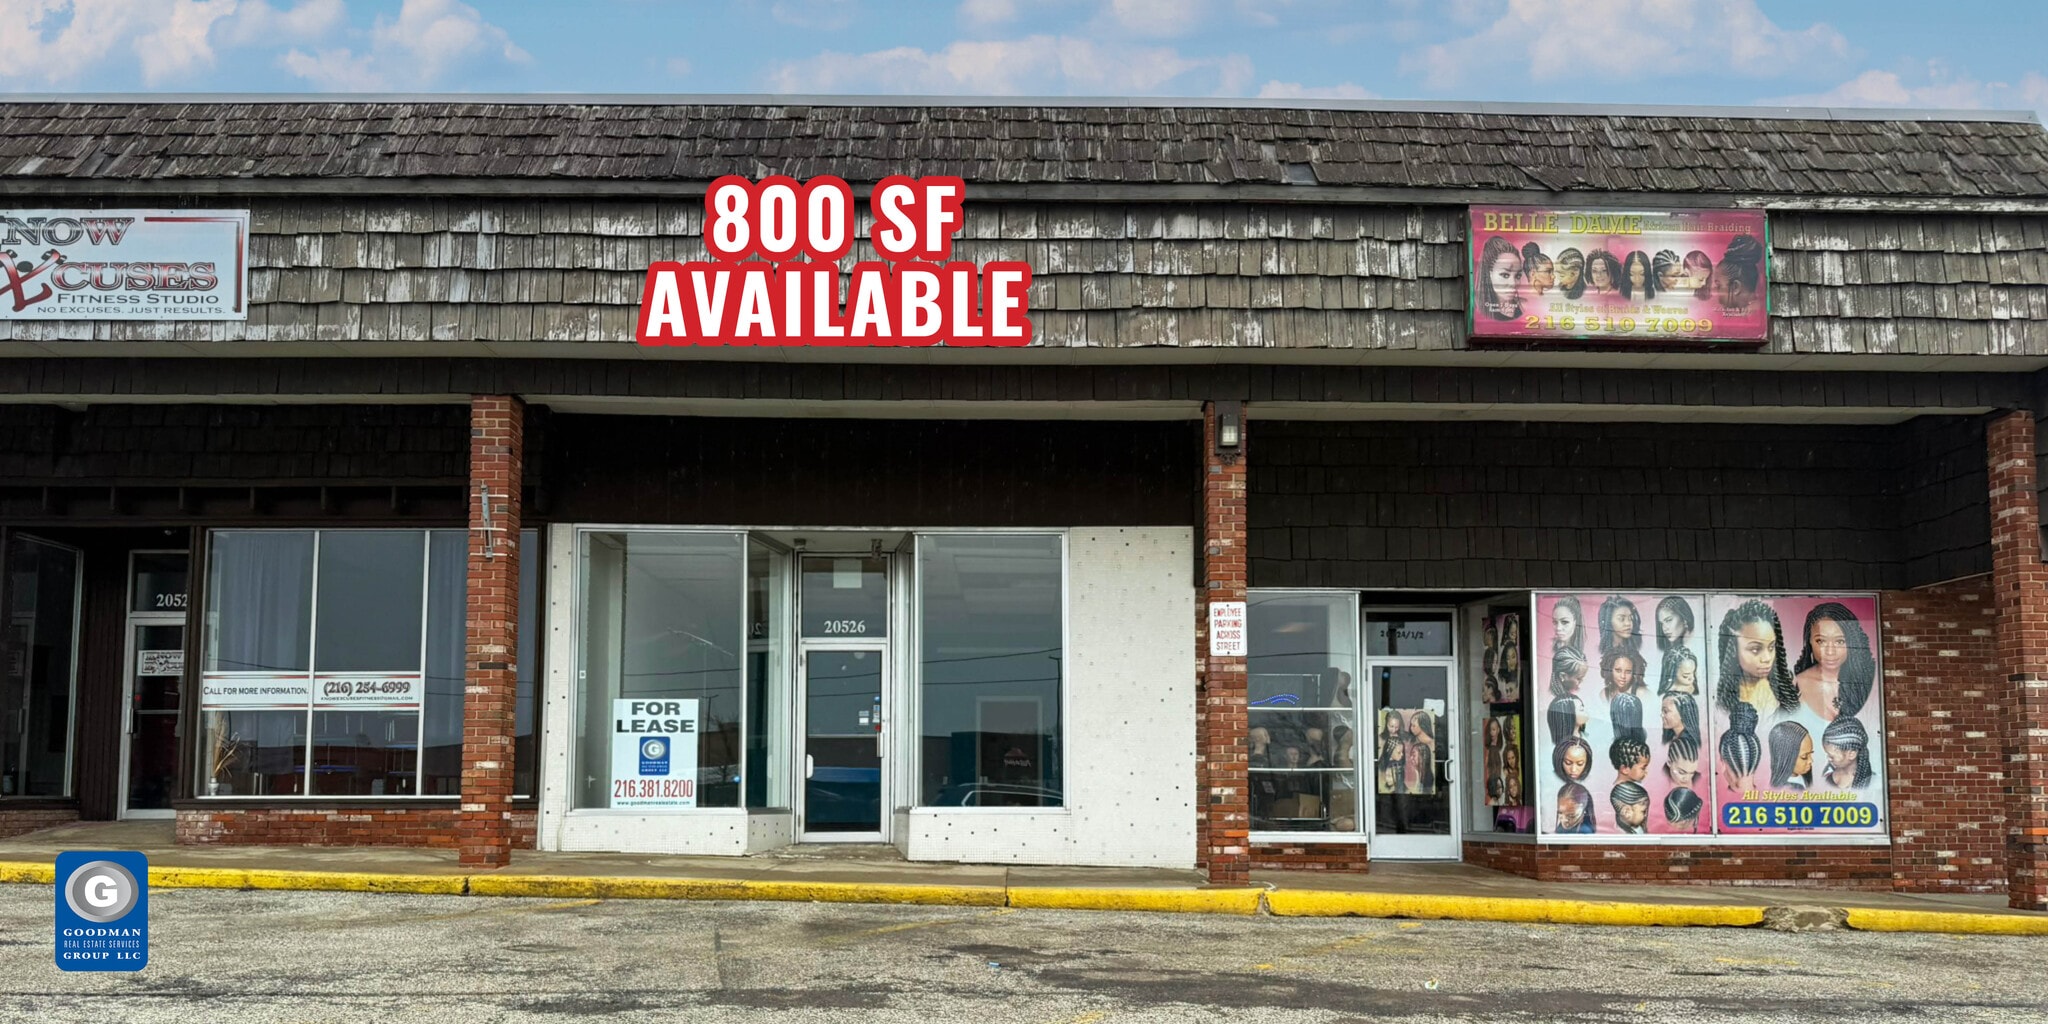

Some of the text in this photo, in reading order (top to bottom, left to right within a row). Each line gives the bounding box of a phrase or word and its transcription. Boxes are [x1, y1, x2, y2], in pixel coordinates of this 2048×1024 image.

[1484, 212, 1642, 235] BELLE DAME
[1707, 222, 1752, 234] Braiding
[0, 216, 135, 246] NOW
[1565, 303, 1594, 314] Styles
[1525, 315, 1713, 332] 216 510 7009
[1213, 608, 1242, 617] EMPLOYEE
[824, 620, 866, 633] 20526
[1214, 619, 1242, 628] PARKING
[1216, 630, 1241, 639] ACROSS
[1216, 642, 1241, 650] STREET
[260, 687, 309, 695] INFORMATION.
[323, 681, 411, 697] (216) 254-6999
[631, 702, 681, 716] FOR
[616, 719, 695, 733] LEASE
[614, 780, 693, 798] 216.381.8200
[1743, 790, 1858, 802] All Styles Available
[1728, 806, 1872, 824] 216 510 7009
